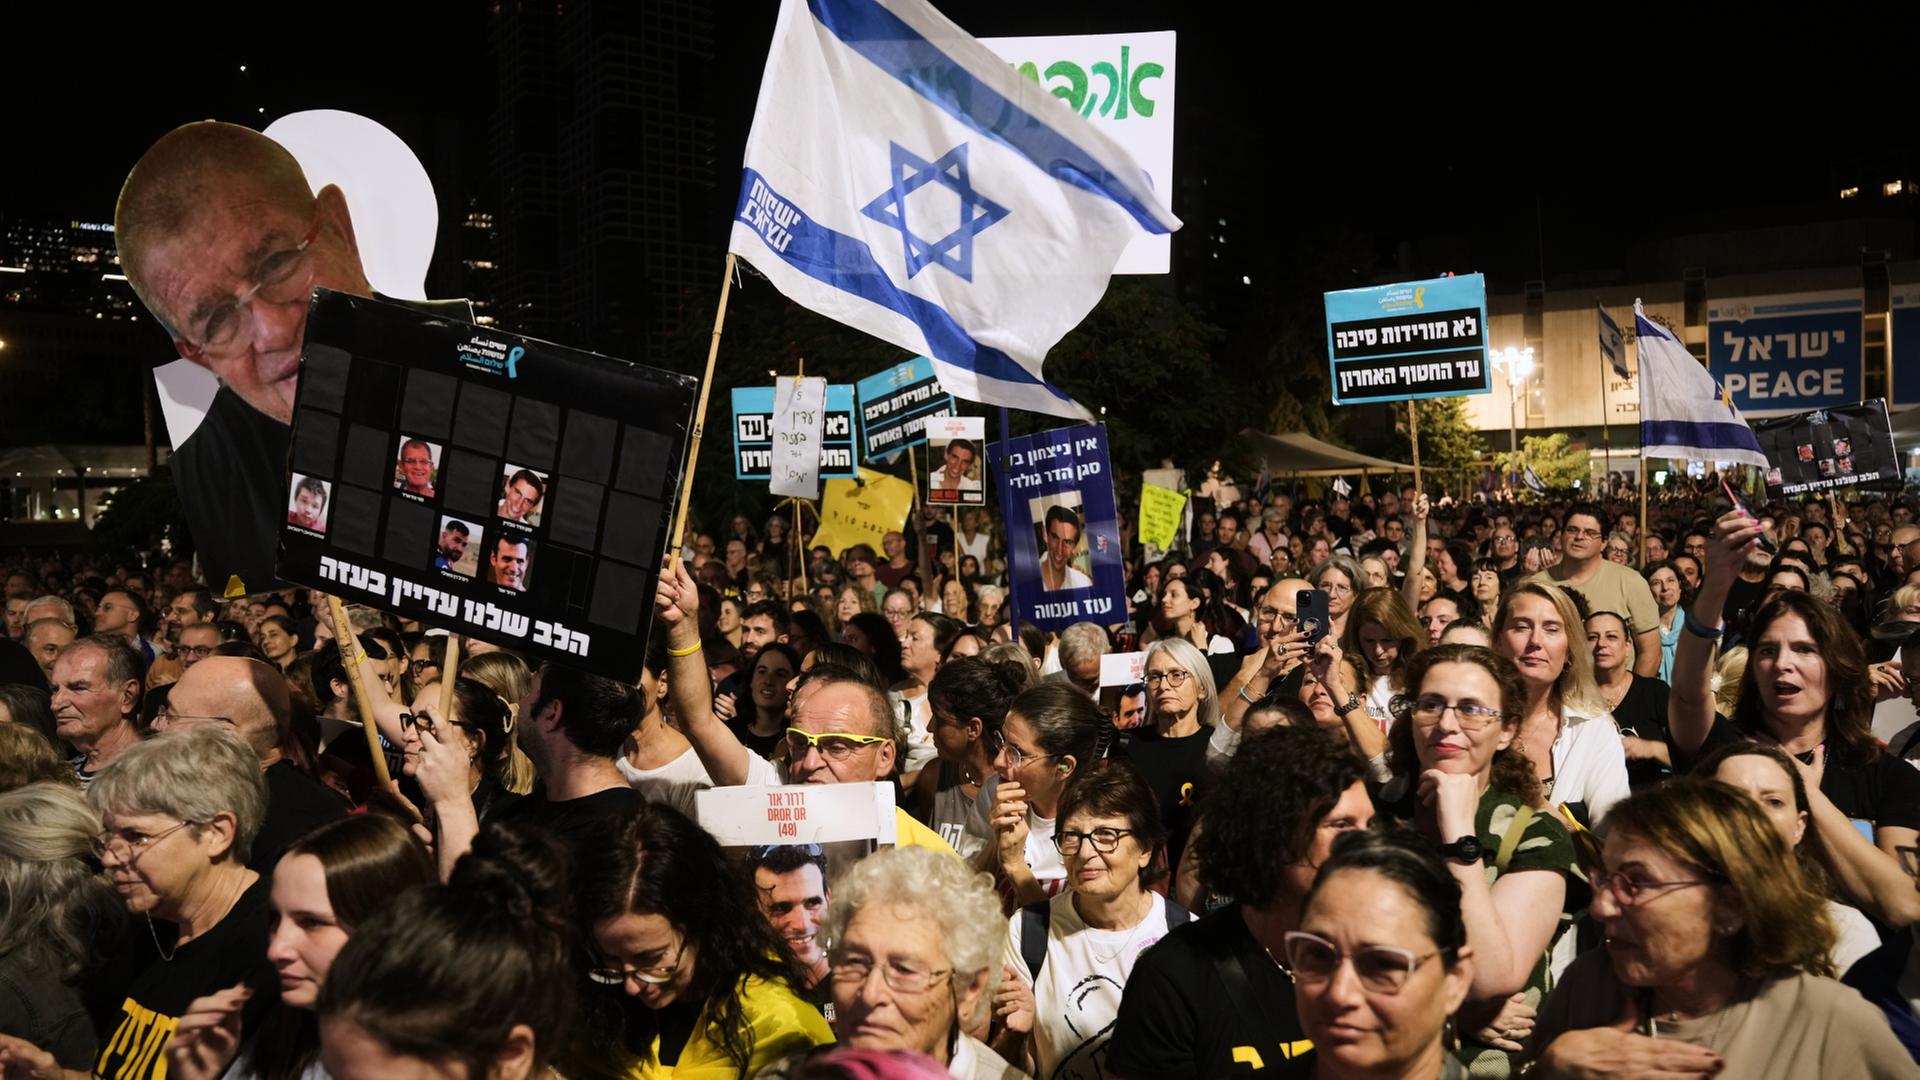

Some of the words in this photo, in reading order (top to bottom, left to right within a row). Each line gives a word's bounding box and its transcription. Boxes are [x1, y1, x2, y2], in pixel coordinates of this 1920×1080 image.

[1381, 321, 1449, 344] מורידות
[1453, 316, 1477, 338] לא
[1336, 328, 1378, 349] סיכה
[1723, 330, 1846, 362] ישראל
[1339, 367, 1397, 392] האחרון
[1400, 362, 1453, 385] החטוף
[1456, 360, 1480, 379] עד
[931, 382, 945, 396] א
[1724, 368, 1845, 399] PEACE
[890, 385, 931, 411] מורידות
[864, 400, 890, 421] סיכה
[741, 419, 762, 436] עד
[826, 415, 849, 435] לא
[868, 425, 903, 452] האחרון
[1075, 437, 1098, 457] אין
[740, 450, 772, 472] חרון
[1027, 443, 1072, 466] ניצחון
[1009, 471, 1042, 489] גולדי
[1044, 467, 1074, 483] הדר
[1077, 462, 1101, 481] סגן
[319, 555, 387, 596] בעזה
[391, 577, 460, 617] עדיין
[1083, 597, 1113, 615] עוז
[464, 599, 530, 638] שלנו
[1034, 601, 1080, 619] וענווה
[532, 619, 591, 657] הלב
[767, 793, 783, 807] אור
[785, 792, 805, 806] דרור
[768, 808, 792, 821] DROR
[794, 807, 807, 821] OR
[778, 823, 797, 837] (48)
